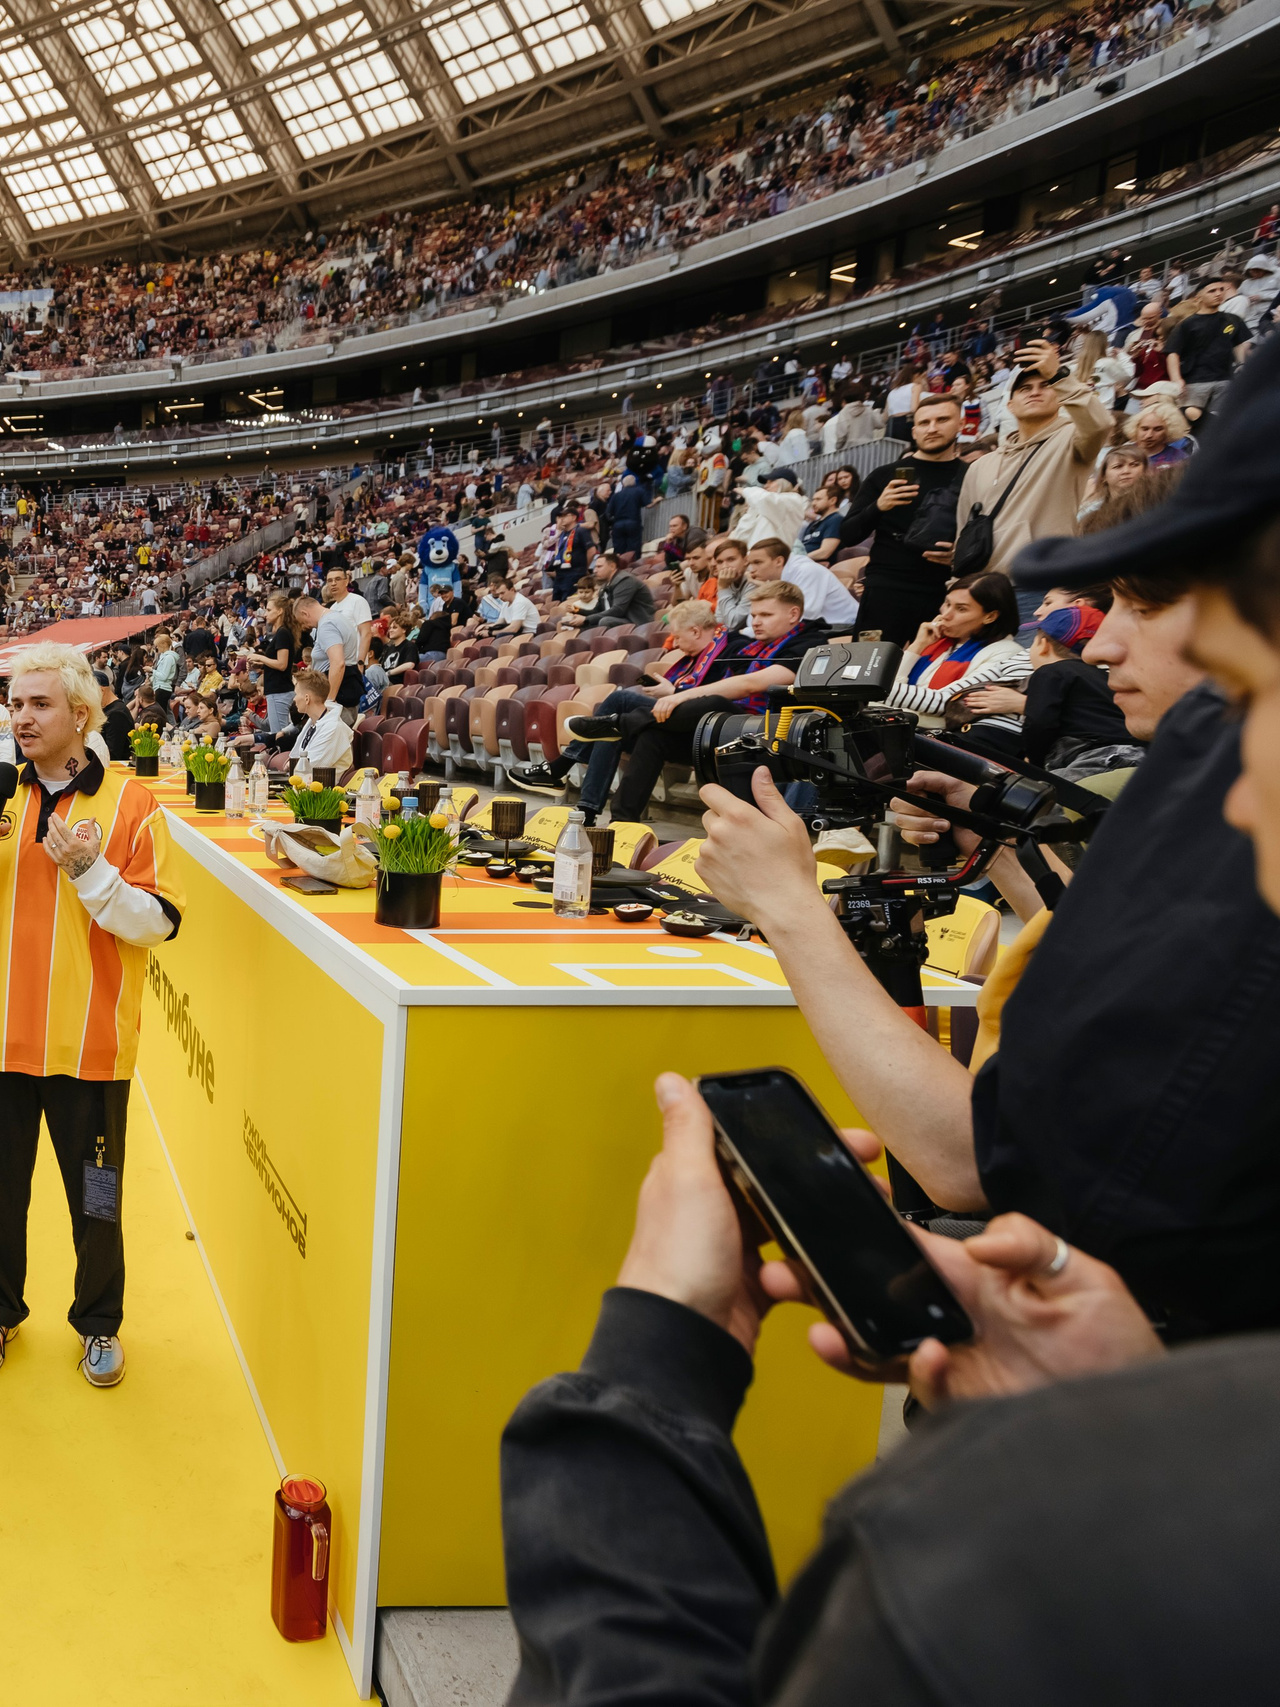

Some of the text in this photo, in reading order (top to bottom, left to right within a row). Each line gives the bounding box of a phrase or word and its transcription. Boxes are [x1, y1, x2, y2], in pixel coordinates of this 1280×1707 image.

[847, 899, 871, 909] 22369
[149, 949, 215, 1105] на трибуне
[243, 1129, 307, 1260] ЧЕМПИОНОВ
